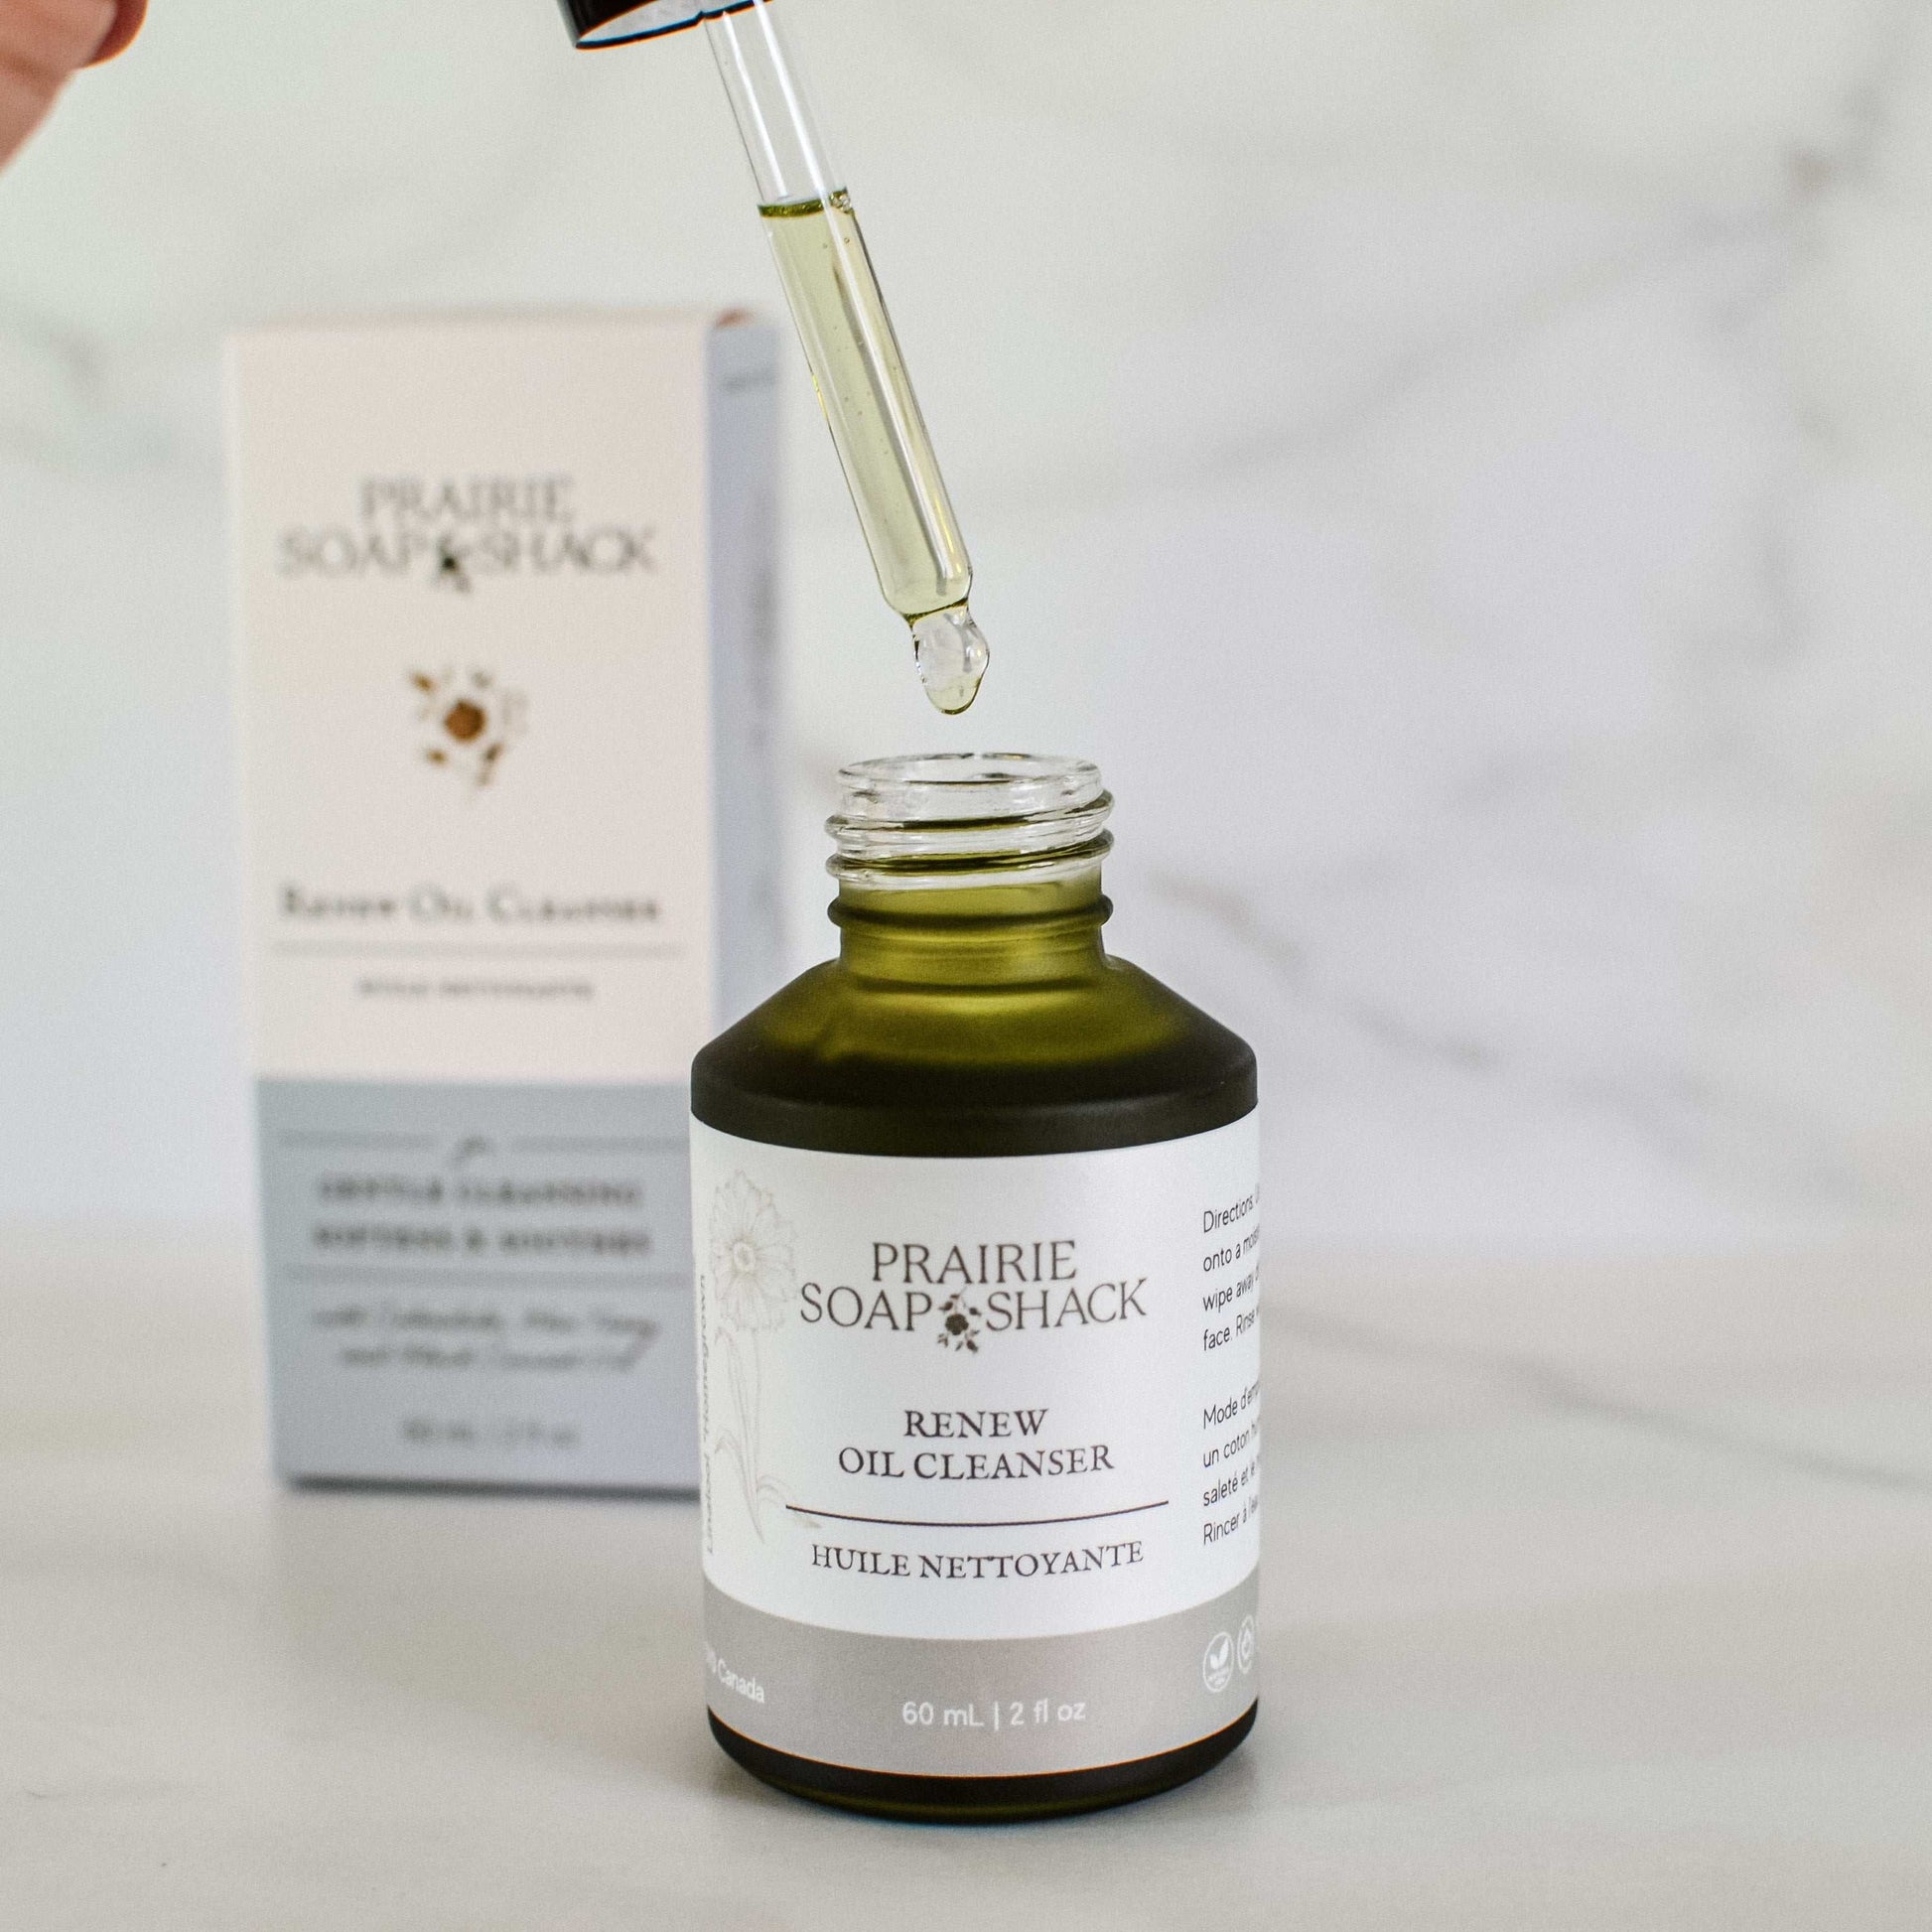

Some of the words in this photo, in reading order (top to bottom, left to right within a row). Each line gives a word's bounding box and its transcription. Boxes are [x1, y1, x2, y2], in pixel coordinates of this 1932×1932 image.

[360, 473, 575, 523] PRAIRIE
[279, 526, 424, 577] SOAP
[479, 526, 658, 576] SHACK
[873, 1241, 1077, 1285] PRAIRIE
[1203, 1248, 1232, 1272] onto
[1235, 1243, 1241, 1259] a
[800, 1282, 932, 1331] SOAP
[986, 1278, 1148, 1331] SHACK
[1203, 1288, 1233, 1312] wipe
[1203, 1327, 1233, 1351] face.
[903, 1409, 1049, 1438] RENEW
[1203, 1396, 1238, 1430] Mode
[839, 1447, 904, 1478] OIL
[913, 1445, 1115, 1480] CLEANSER
[1203, 1449, 1220, 1468] un
[1223, 1431, 1250, 1458] coton
[1203, 1471, 1238, 1507] saleté
[1203, 1512, 1241, 1546] Rincer
[812, 1544, 910, 1577] HUILE
[919, 1541, 1144, 1579] NETTOYANTE
[718, 1658, 764, 1704] Canada
[902, 1701, 934, 1725] 60
[944, 1703, 985, 1726] mL
[1010, 1701, 1025, 1725] 2
[1034, 1698, 1048, 1724] fl
[1057, 1702, 1086, 1722] oz
